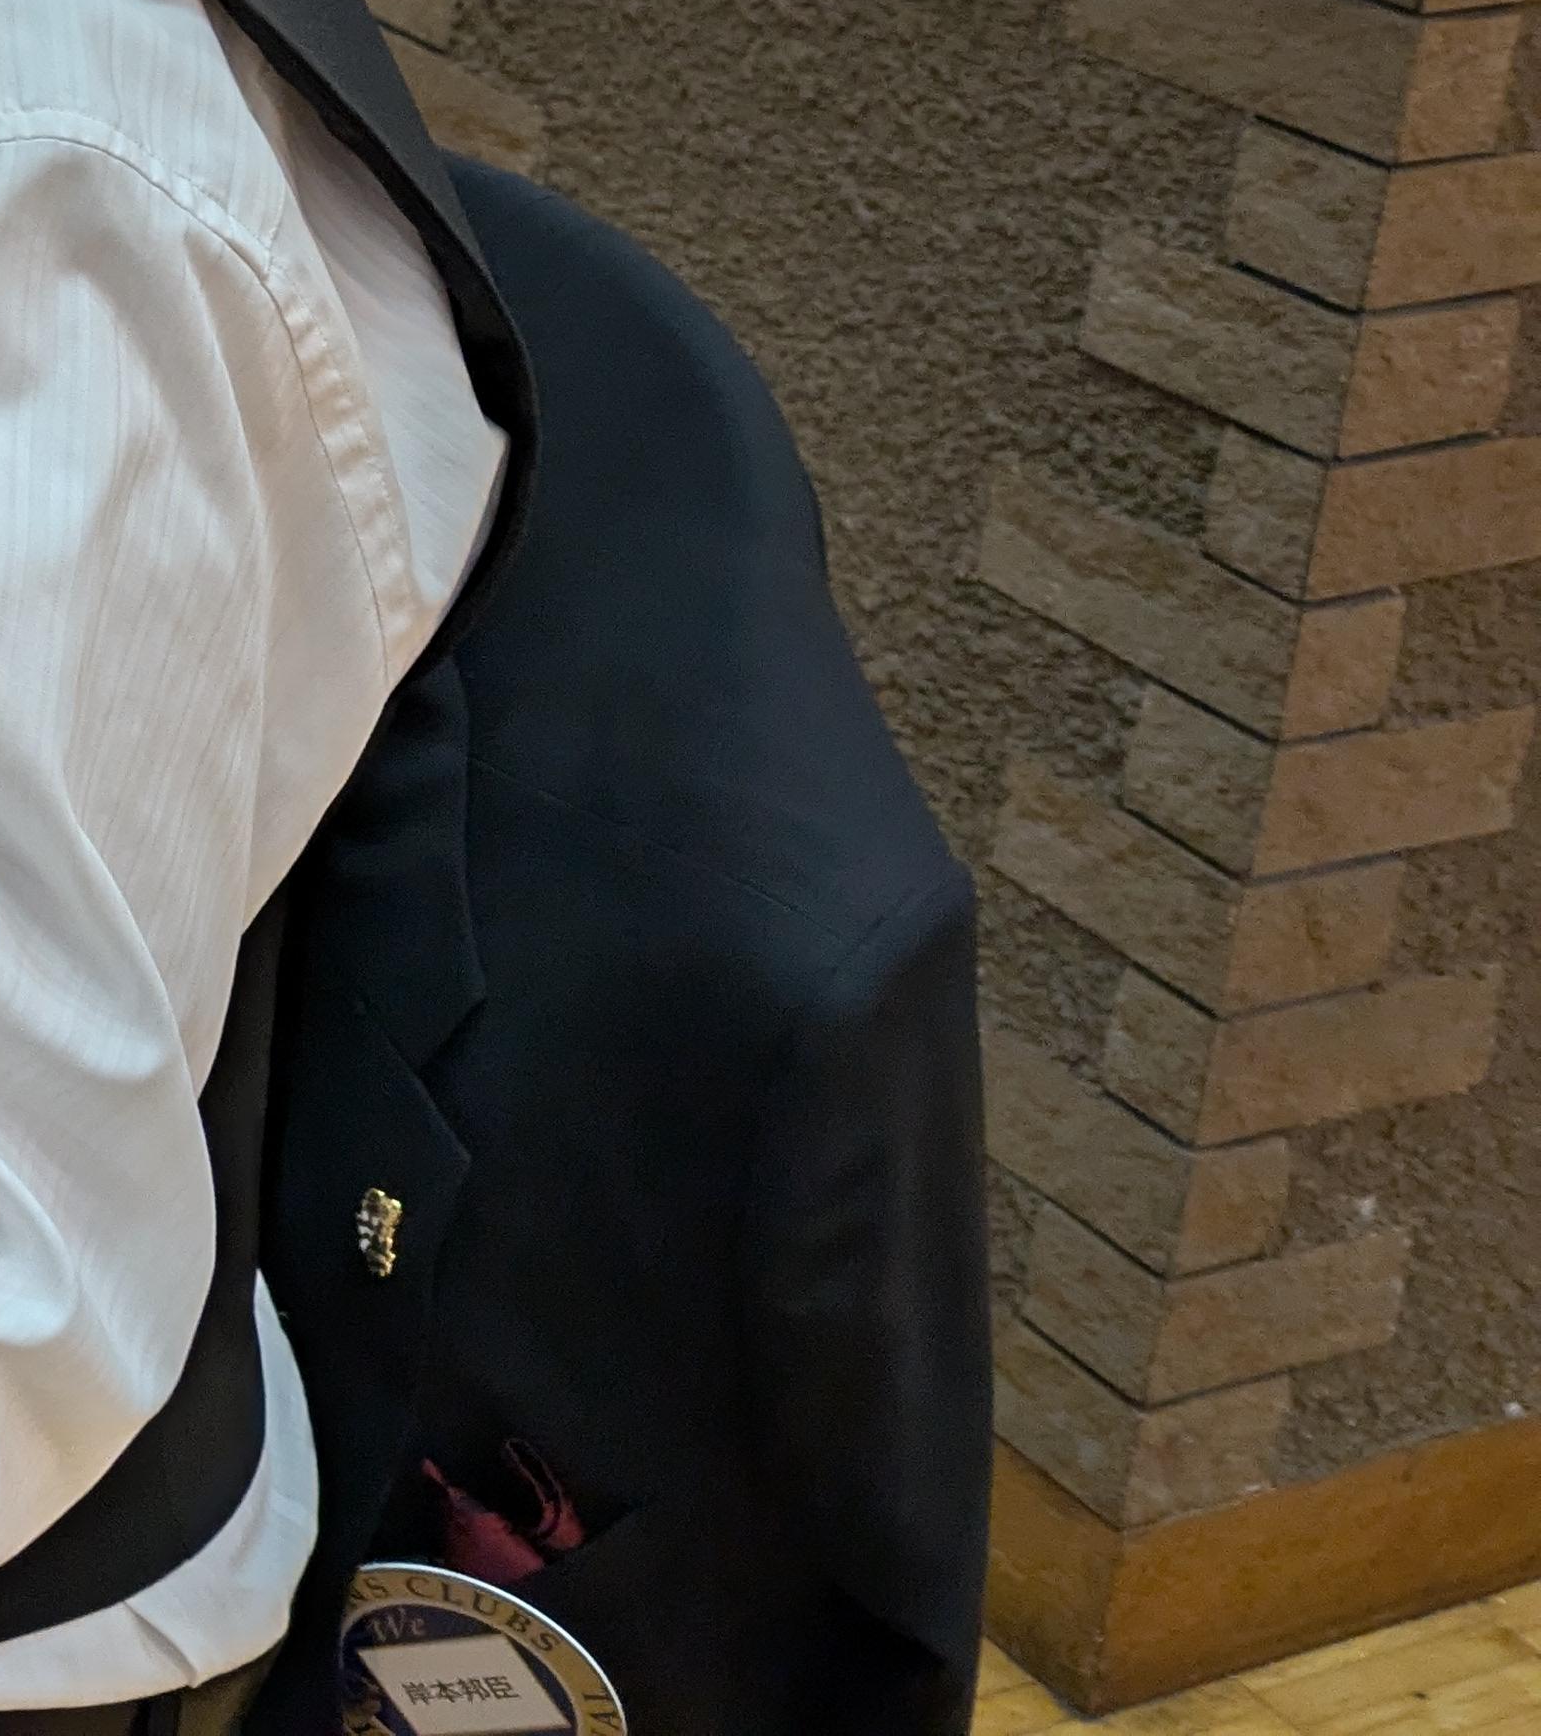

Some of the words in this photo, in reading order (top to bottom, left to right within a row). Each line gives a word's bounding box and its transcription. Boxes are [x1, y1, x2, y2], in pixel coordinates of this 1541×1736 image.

[405, 1576, 560, 1652] CLUBS
[402, 1675, 520, 1705] 岸本邦臣
